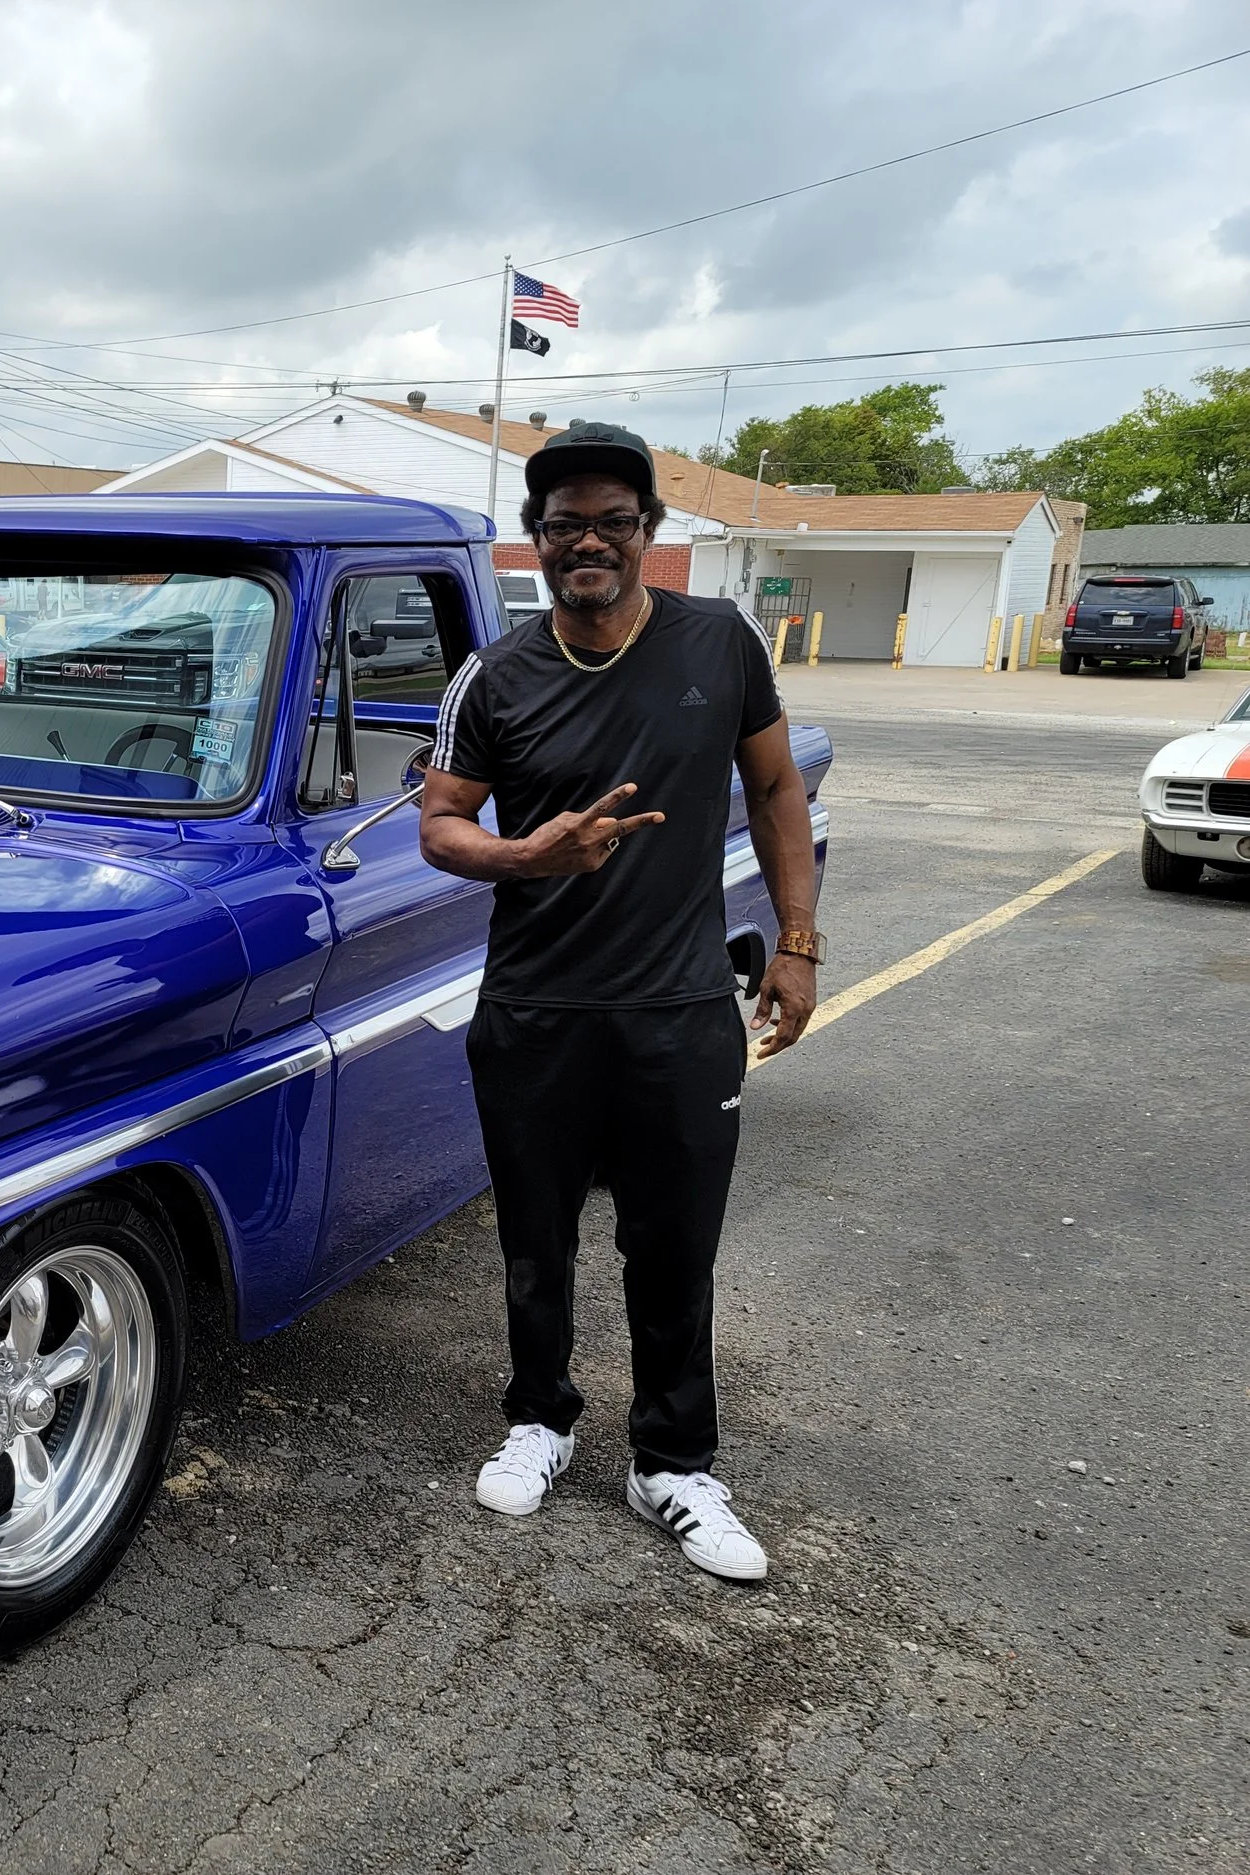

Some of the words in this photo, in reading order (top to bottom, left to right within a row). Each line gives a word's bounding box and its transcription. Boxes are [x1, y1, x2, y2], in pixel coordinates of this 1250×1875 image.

[61, 662, 124, 680] GMC
[679, 698, 708, 706] adidas
[199, 739, 228, 752] 1000
